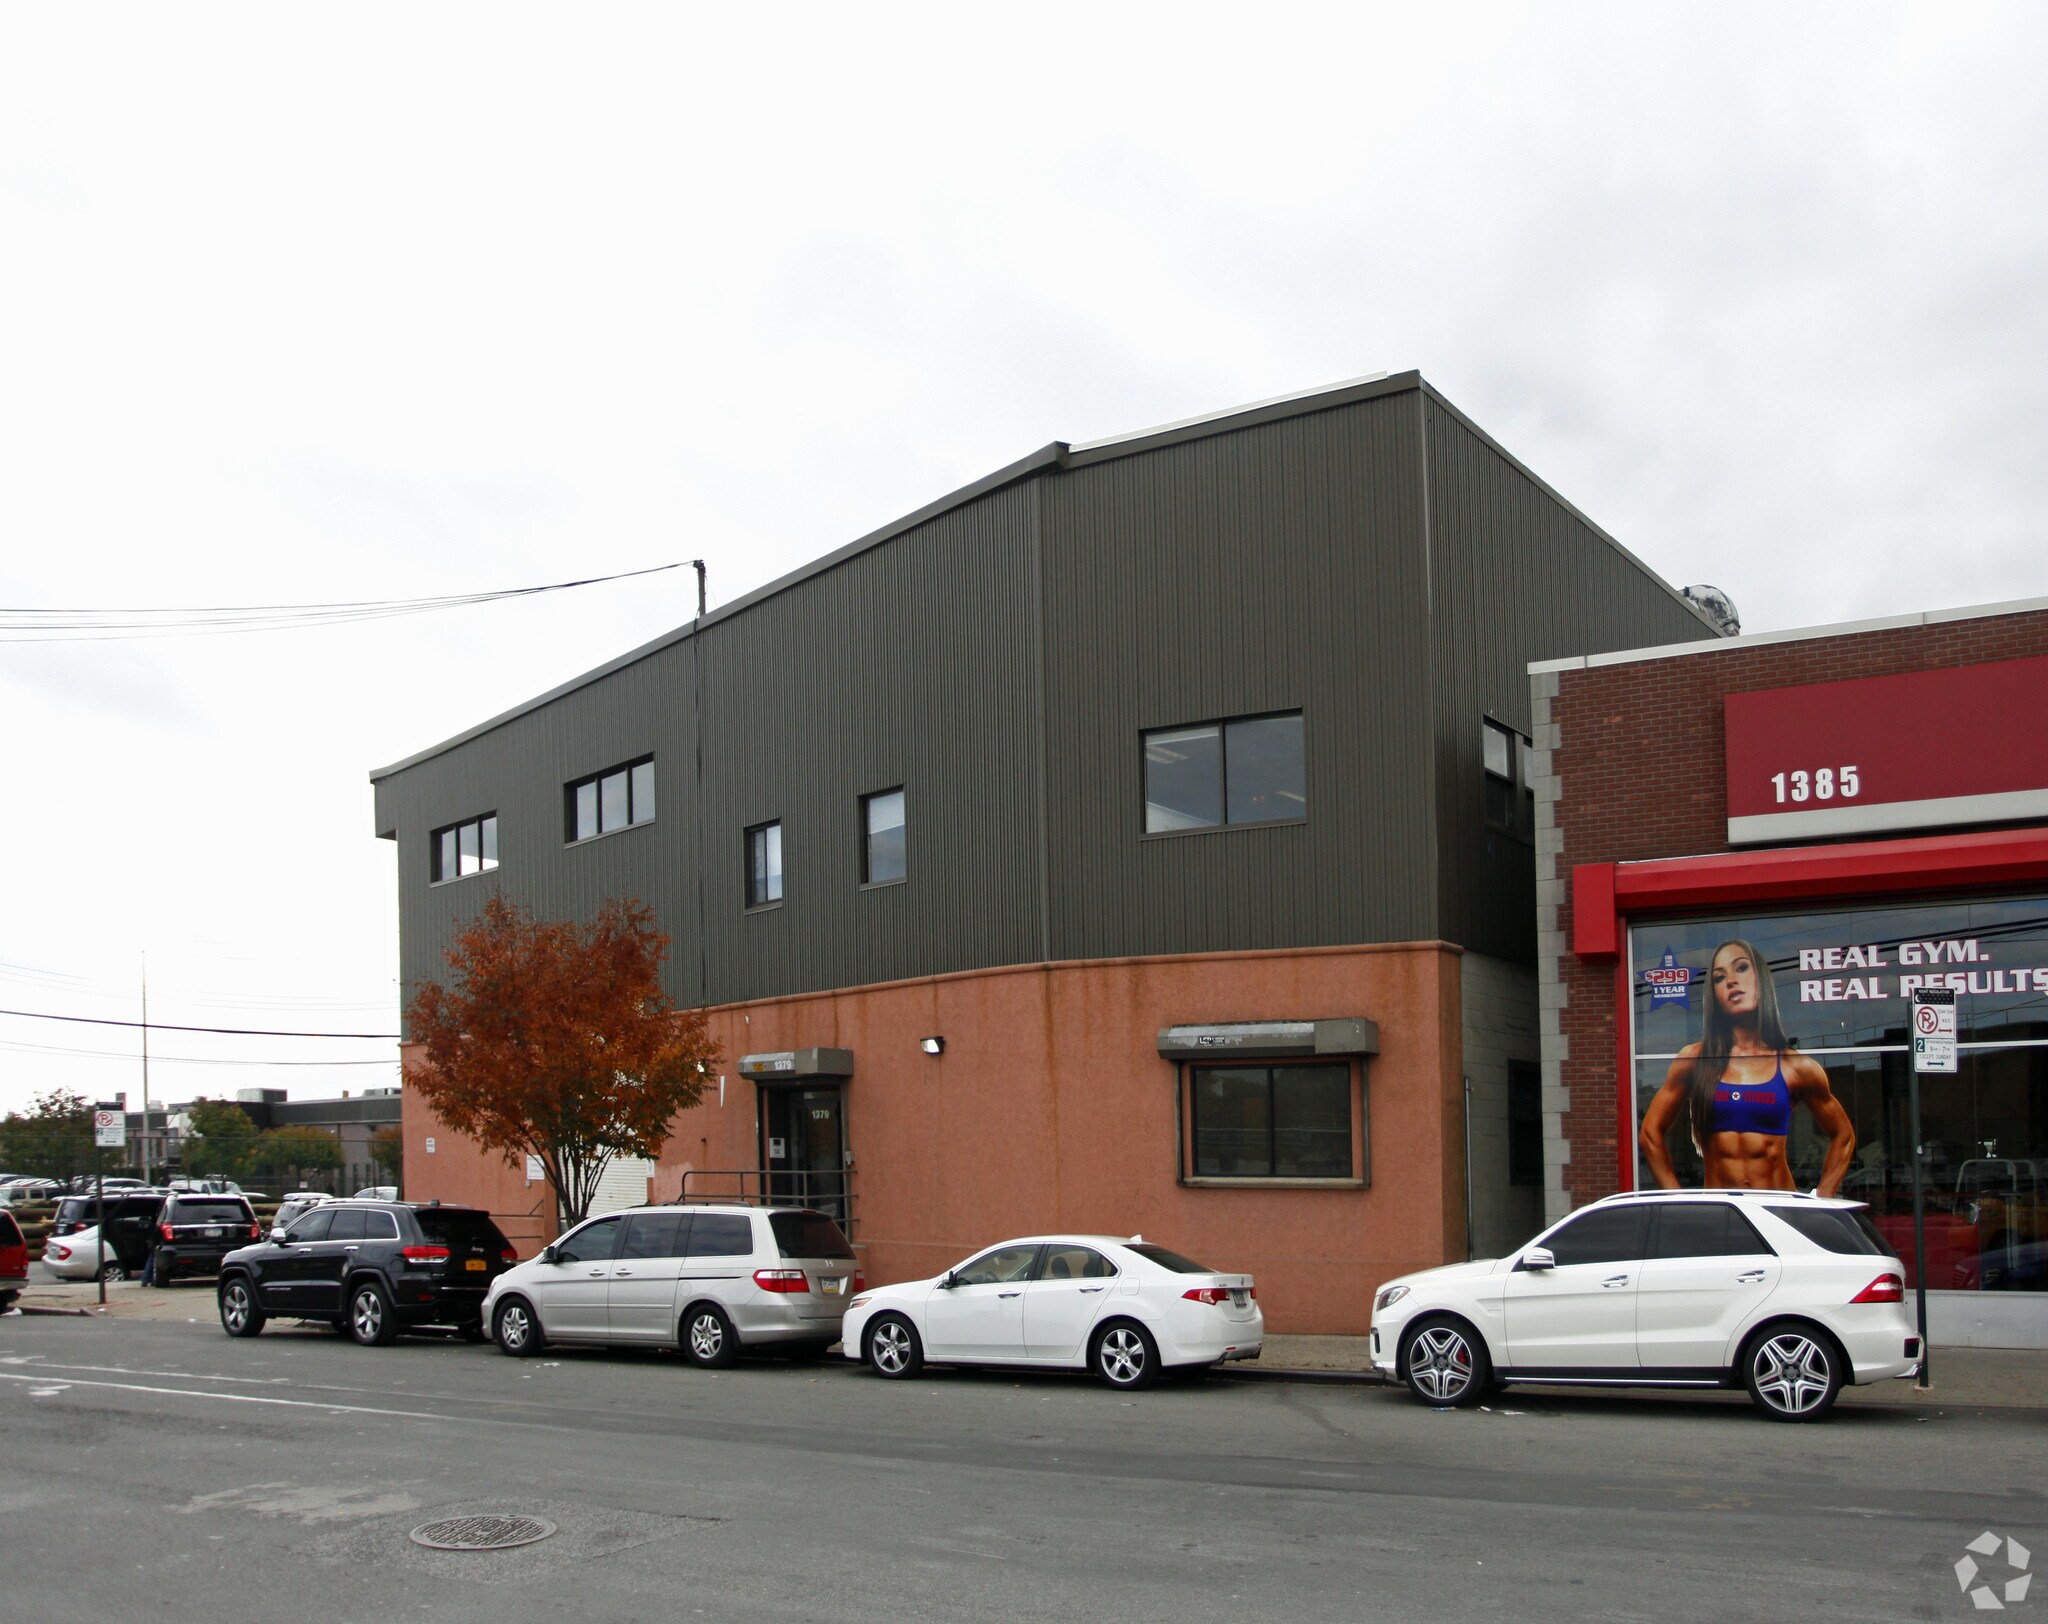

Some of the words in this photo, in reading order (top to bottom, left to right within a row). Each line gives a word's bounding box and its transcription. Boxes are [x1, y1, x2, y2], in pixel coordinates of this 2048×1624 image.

[1770, 765, 1859, 803] 1385
[1799, 944, 1888, 971] REAL
[1898, 938, 1990, 966] GYM.
[1645, 968, 1689, 985] $299
[1660, 986, 1685, 994] YEAR
[1799, 976, 1888, 1003] REAL
[1917, 1039, 1923, 1052] 2
[774, 1060, 792, 1071] 1379
[812, 1109, 830, 1119] 1379
